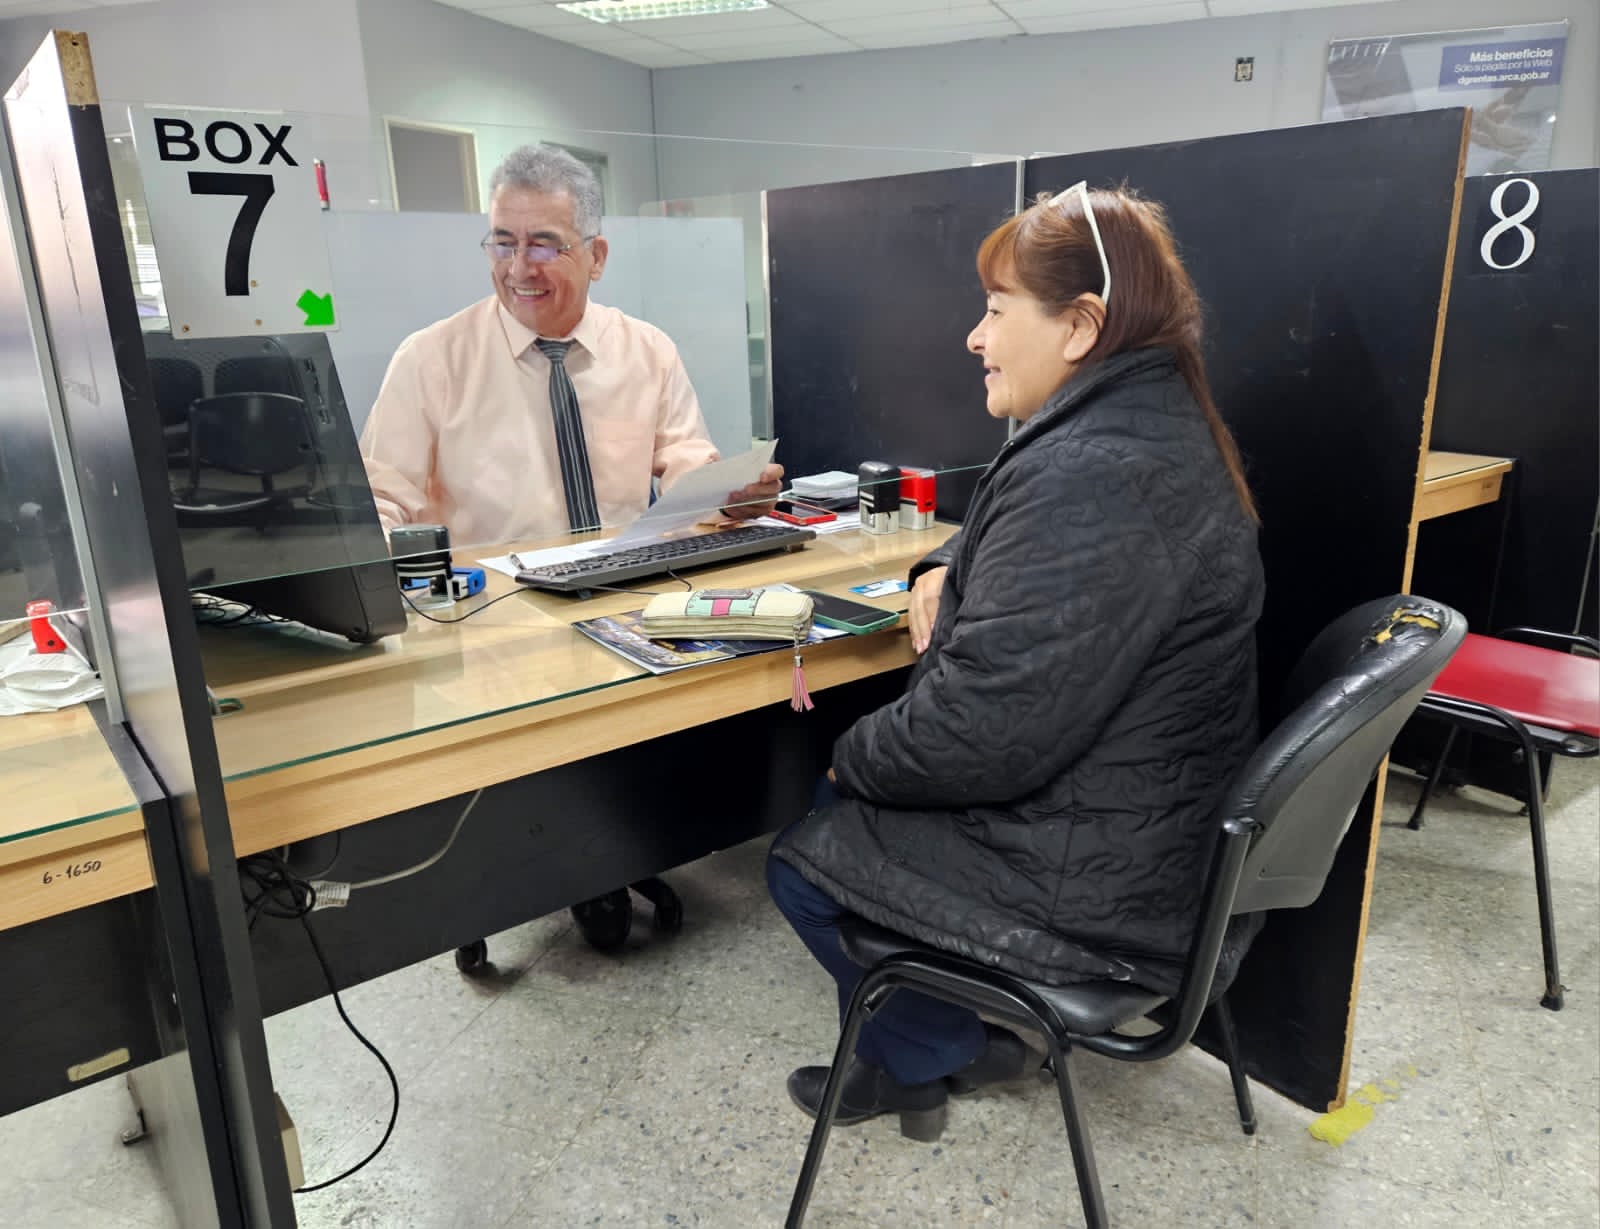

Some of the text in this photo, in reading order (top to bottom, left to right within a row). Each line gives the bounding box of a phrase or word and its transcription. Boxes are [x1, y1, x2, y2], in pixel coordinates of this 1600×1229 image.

[1470, 48, 1553, 63] Más beneficios
[1508, 61, 1522, 71] por
[1531, 58, 1553, 68] Web
[153, 117, 299, 167] BOX
[187, 171, 276, 297] 7
[1480, 178, 1540, 270] 8
